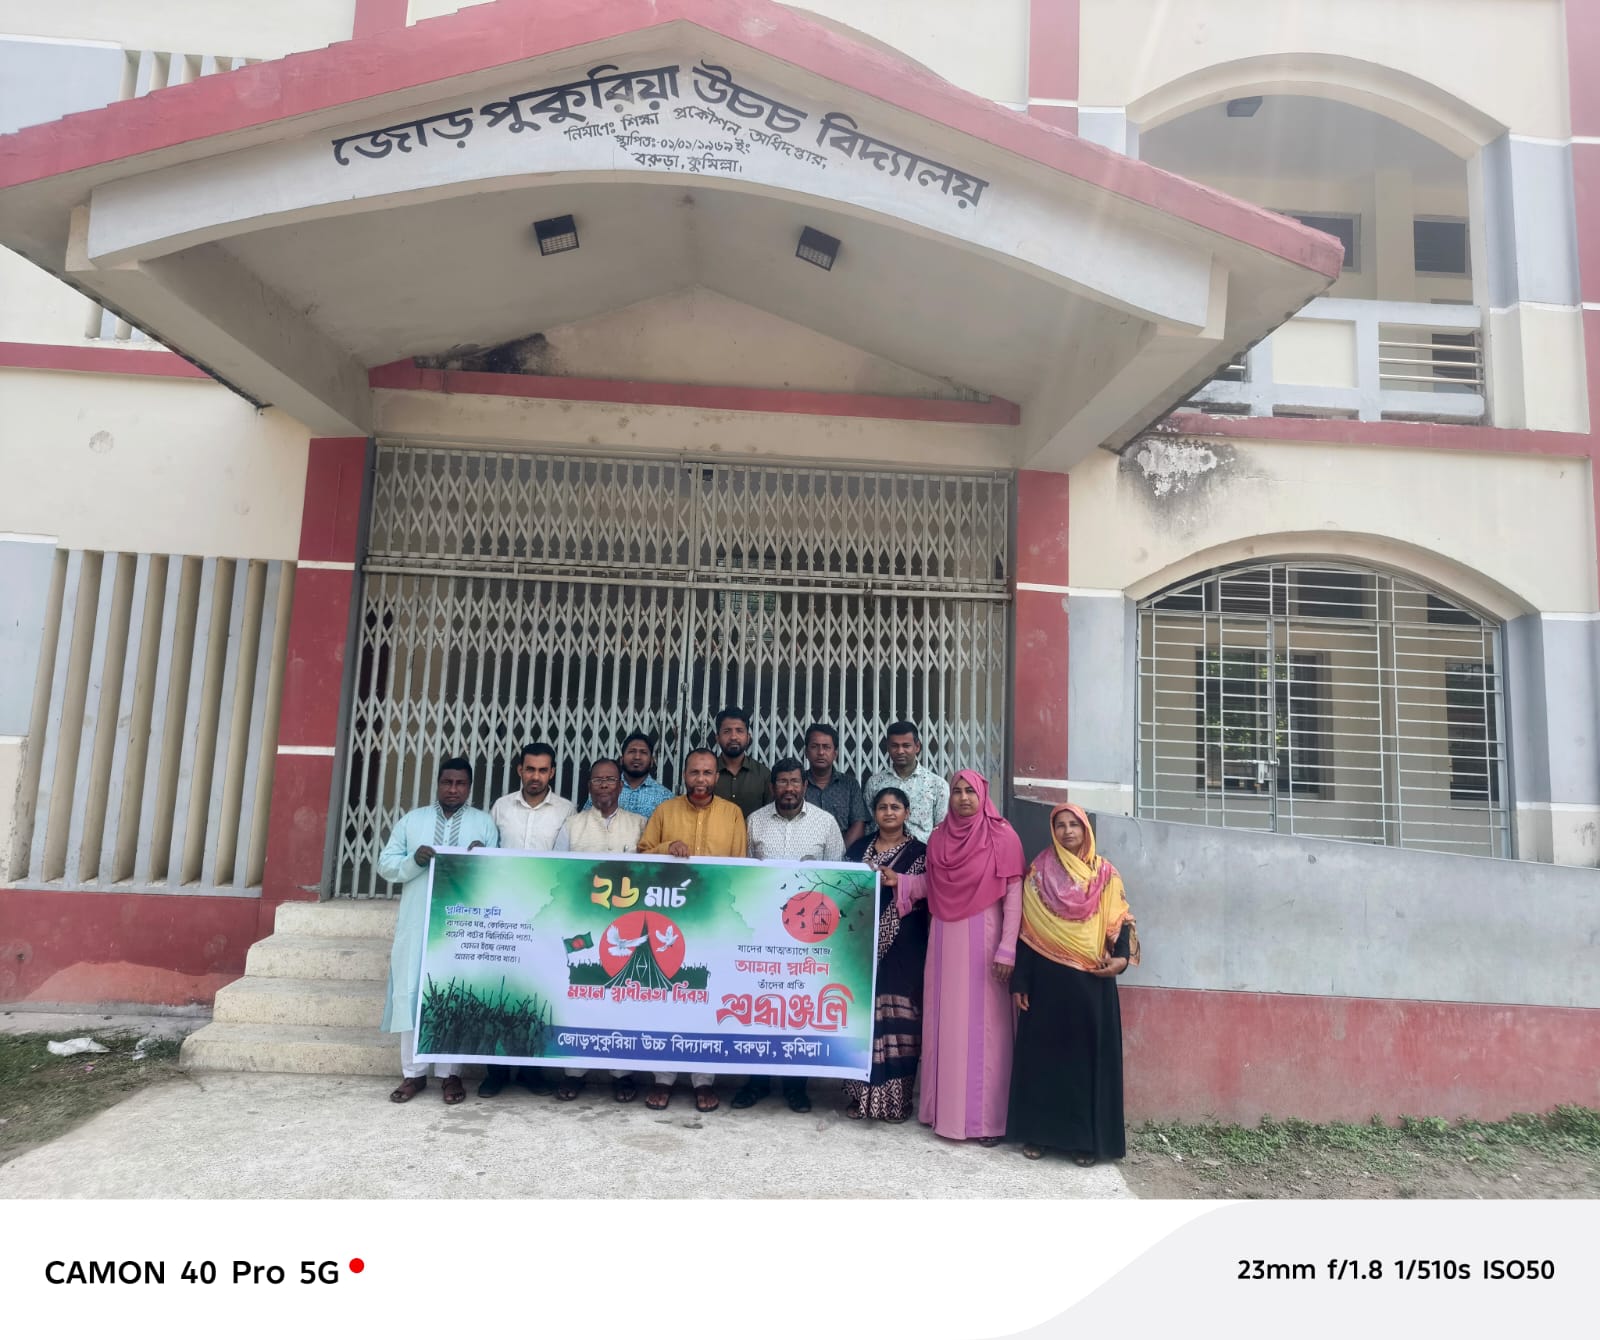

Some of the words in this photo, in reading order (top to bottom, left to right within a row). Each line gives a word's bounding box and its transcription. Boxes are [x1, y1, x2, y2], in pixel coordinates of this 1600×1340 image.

[619, 112, 660, 132] শিক্ষা
[815, 111, 990, 209] বিদ্যালয়
[590, 874, 640, 909] ২৬
[644, 878, 692, 908] মার্চ
[484, 906, 502, 919] তুমি
[737, 944, 762, 954] যাদের
[809, 947, 831, 956] আজ
[734, 959, 782, 976] আমরা
[786, 956, 830, 977] স্বাধীন
[567, 985, 605, 1000] মহান
[611, 978, 668, 1004] স্বাধীনতা
[671, 981, 710, 1004] দিবস
[757, 978, 785, 990] তাঁদের
[786, 979, 806, 990] প্রতি
[715, 982, 855, 1031] শ্রদ্ধাঞ্জলি
[557, 1031, 637, 1052] জোড়পুকুরিয়া
[641, 1033, 668, 1050] উচ্চ
[671, 1035, 729, 1057] বিদ্যালয়,
